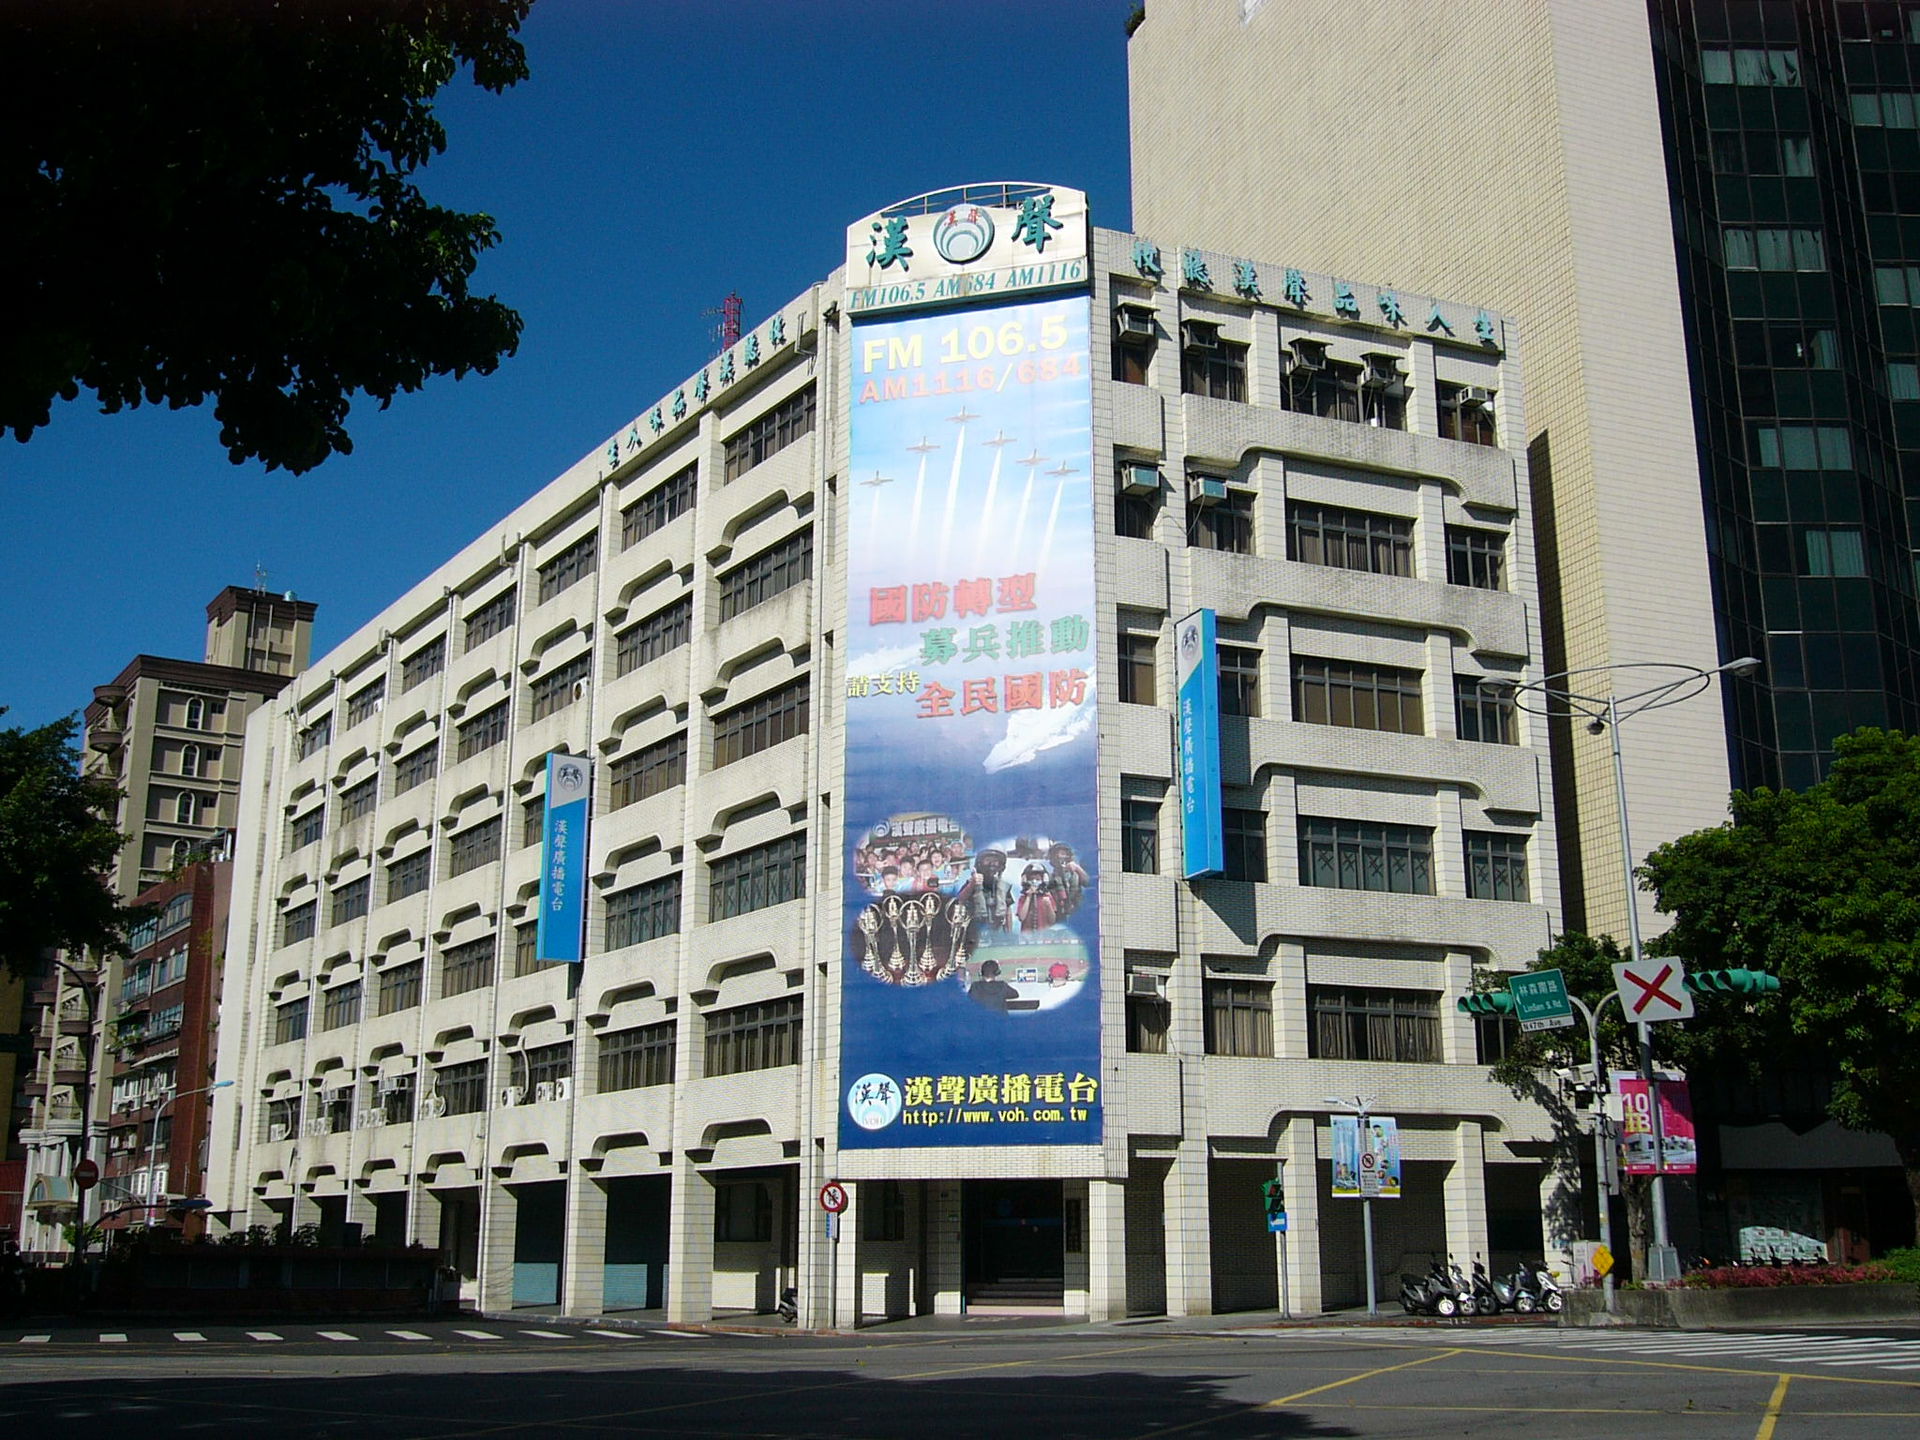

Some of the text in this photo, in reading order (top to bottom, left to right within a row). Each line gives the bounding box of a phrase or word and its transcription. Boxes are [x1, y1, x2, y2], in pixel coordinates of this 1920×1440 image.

[866, 192, 1064, 272] 漢 聲
[850, 260, 1083, 310] FM106.5 AM684 AM1116
[1130, 240, 1495, 342] 收聽漢聲品味人生
[863, 314, 1069, 375] FM 106.5
[859, 354, 1083, 406] AM1116/684
[869, 571, 1038, 627] 國防轉型
[919, 613, 1091, 667] 募兵推動
[846, 668, 1089, 719] 請支持 全民國防
[551, 818, 569, 912] 漢聲廣播電台
[854, 1081, 896, 1107] 漢聲
[903, 1071, 1099, 1106] 漢聲廣播電台
[902, 1106, 1088, 1128] http://www.voh.com.tw
